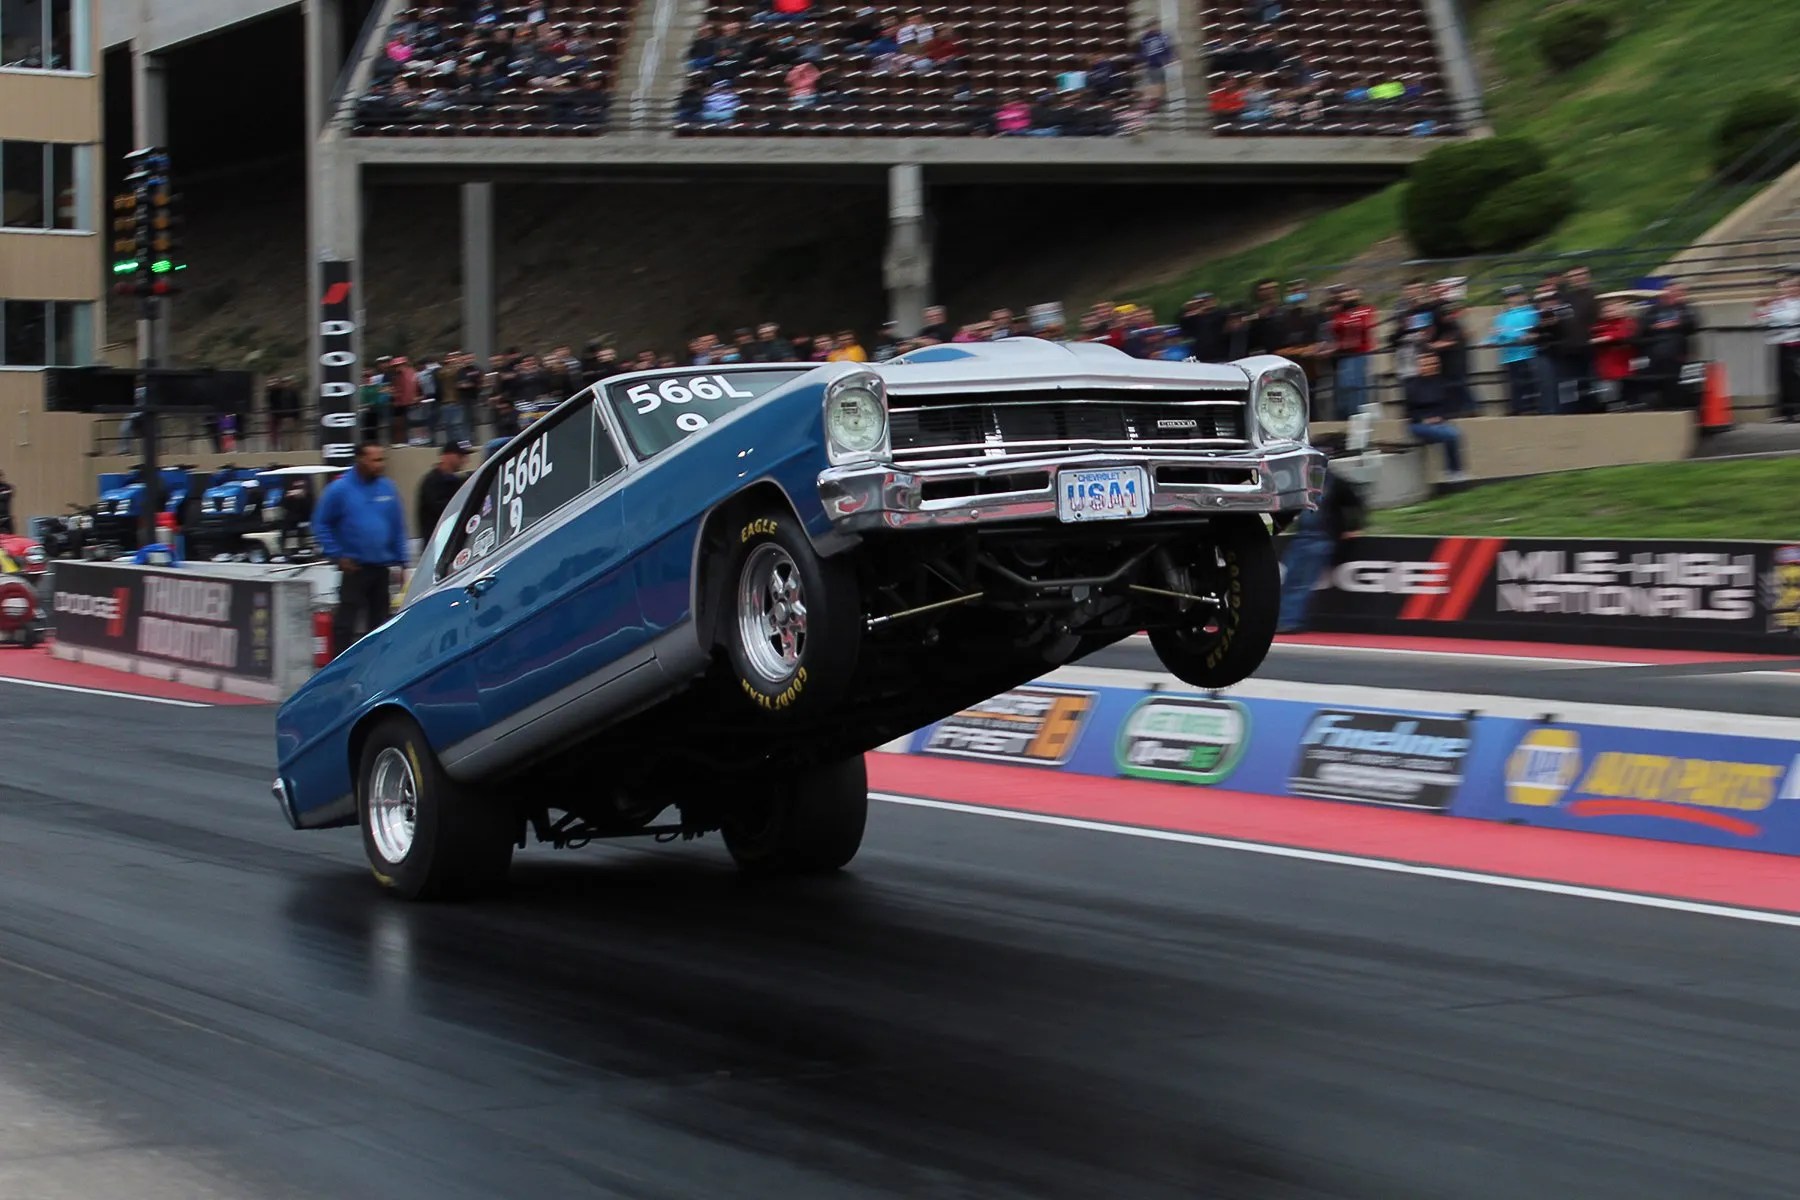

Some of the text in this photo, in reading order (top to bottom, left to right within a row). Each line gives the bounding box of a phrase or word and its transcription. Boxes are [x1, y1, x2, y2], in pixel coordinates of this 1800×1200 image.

[320, 320, 357, 458] DODGE
[626, 375, 754, 415] 566L
[502, 431, 553, 505] 566L
[1077, 472, 1121, 483] CHEVROLET
[741, 518, 778, 543] EAGLE
[53, 591, 122, 620] DODGE
[1497, 583, 1756, 619] NATIONALS
